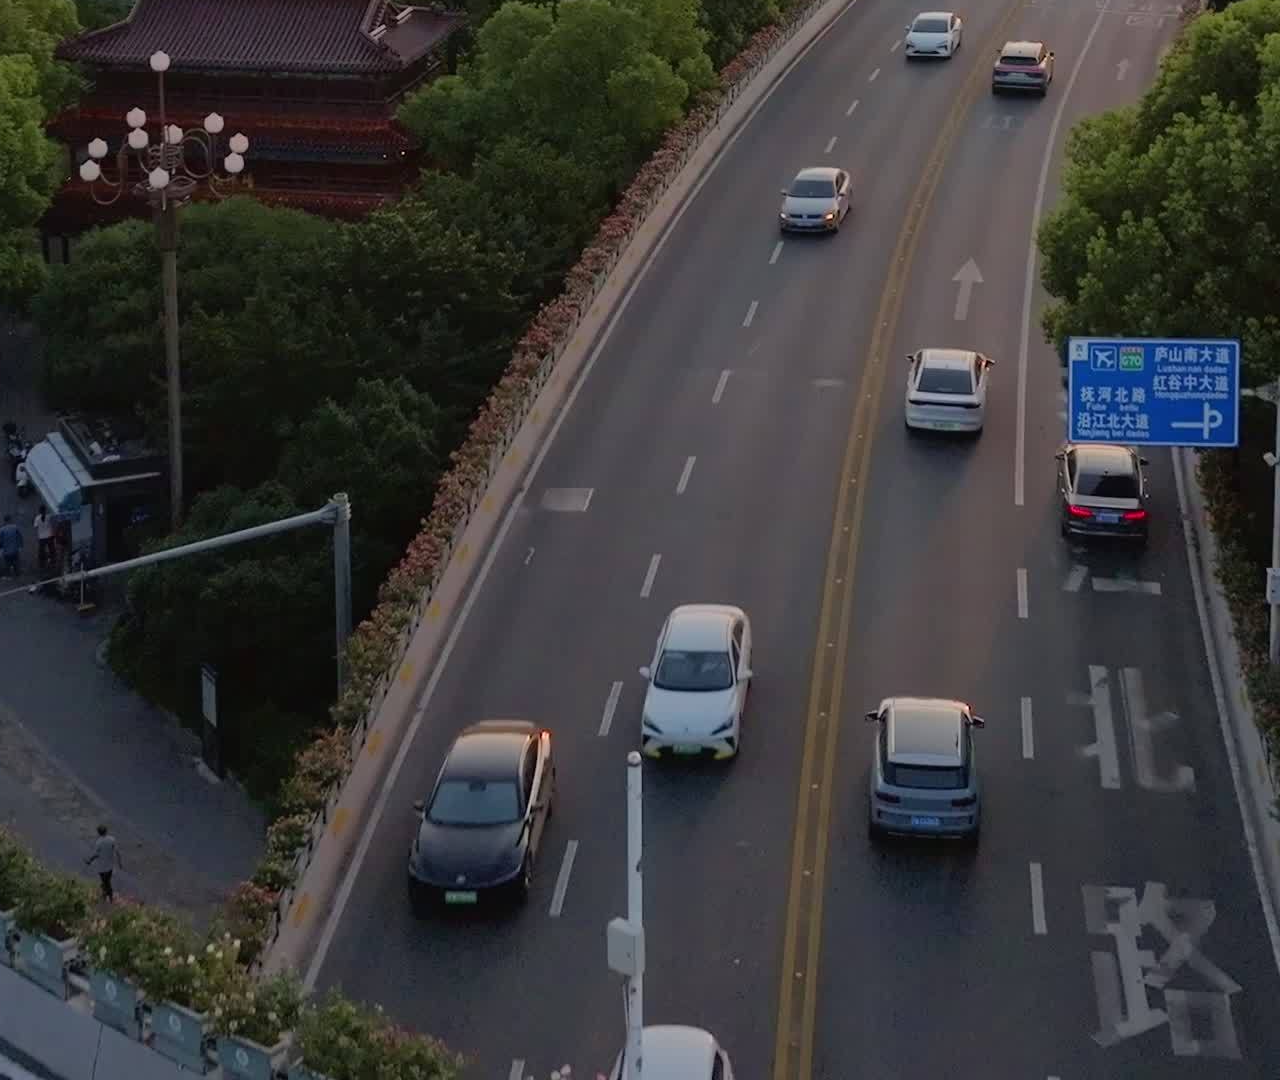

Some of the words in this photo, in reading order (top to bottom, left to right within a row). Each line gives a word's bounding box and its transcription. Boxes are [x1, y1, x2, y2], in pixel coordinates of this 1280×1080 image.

[1121, 355, 1142, 367] G70
[1154, 346, 1230, 364] 庐山南大道
[1152, 374, 1230, 391] 红谷中大道
[1079, 386, 1146, 403] 抚河北路
[1077, 412, 1150, 429] 沿江北大道
